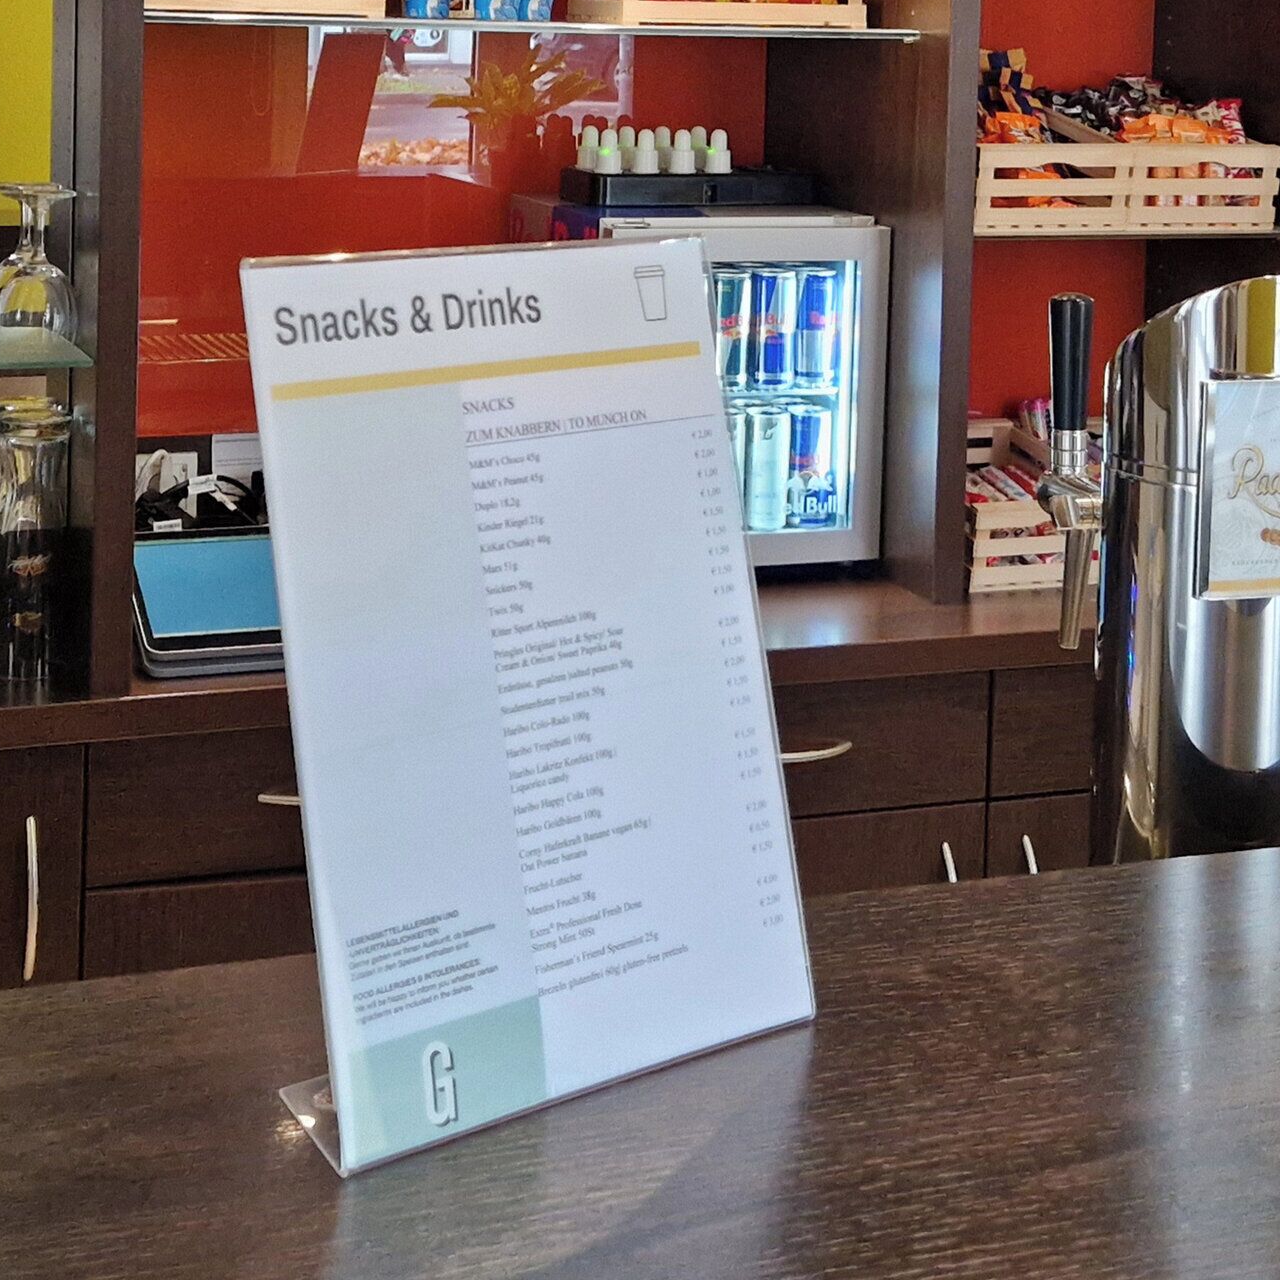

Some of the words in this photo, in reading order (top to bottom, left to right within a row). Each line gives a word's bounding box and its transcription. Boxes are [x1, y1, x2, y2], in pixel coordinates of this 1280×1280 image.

[275, 298, 399, 345] Snacks
[411, 295, 433, 333] &
[442, 287, 542, 330] Drinks
[462, 397, 515, 415] SNACKS
[466, 428, 493, 443] ZUM
[496, 420, 561, 439] KNABBERN
[569, 418, 585, 430] TO
[588, 411, 629, 427] MUNCH
[630, 410, 647, 421] ON
[469, 458, 499, 469] M&M's
[471, 479, 502, 490] M&M's
[474, 501, 498, 511] Duplo
[806, 494, 837, 515] Bull
[477, 522, 503, 532] Kinder
[506, 538, 535, 549] Chunky
[485, 585, 517, 595] Snickers
[489, 607, 508, 616] Twix
[514, 623, 534, 634] Sport
[503, 725, 529, 737] Haribo
[506, 747, 532, 759] Haribo
[574, 732, 591, 743] 100g
[509, 768, 535, 780] Haribo
[513, 803, 539, 816] Haribo
[541, 797, 564, 808] Happy
[566, 791, 584, 802] Cola
[586, 786, 604, 797] 100g
[516, 824, 542, 837] Haribo
[584, 809, 602, 819] 100g
[520, 863, 534, 873] Oat
[536, 857, 559, 869] Power
[602, 905, 622, 918] Fresh
[531, 940, 557, 951] Strong
[558, 934, 576, 944] Mint
[582, 946, 606, 961] Friend
[645, 931, 659, 942] 25g
[424, 1041, 458, 1127] G
